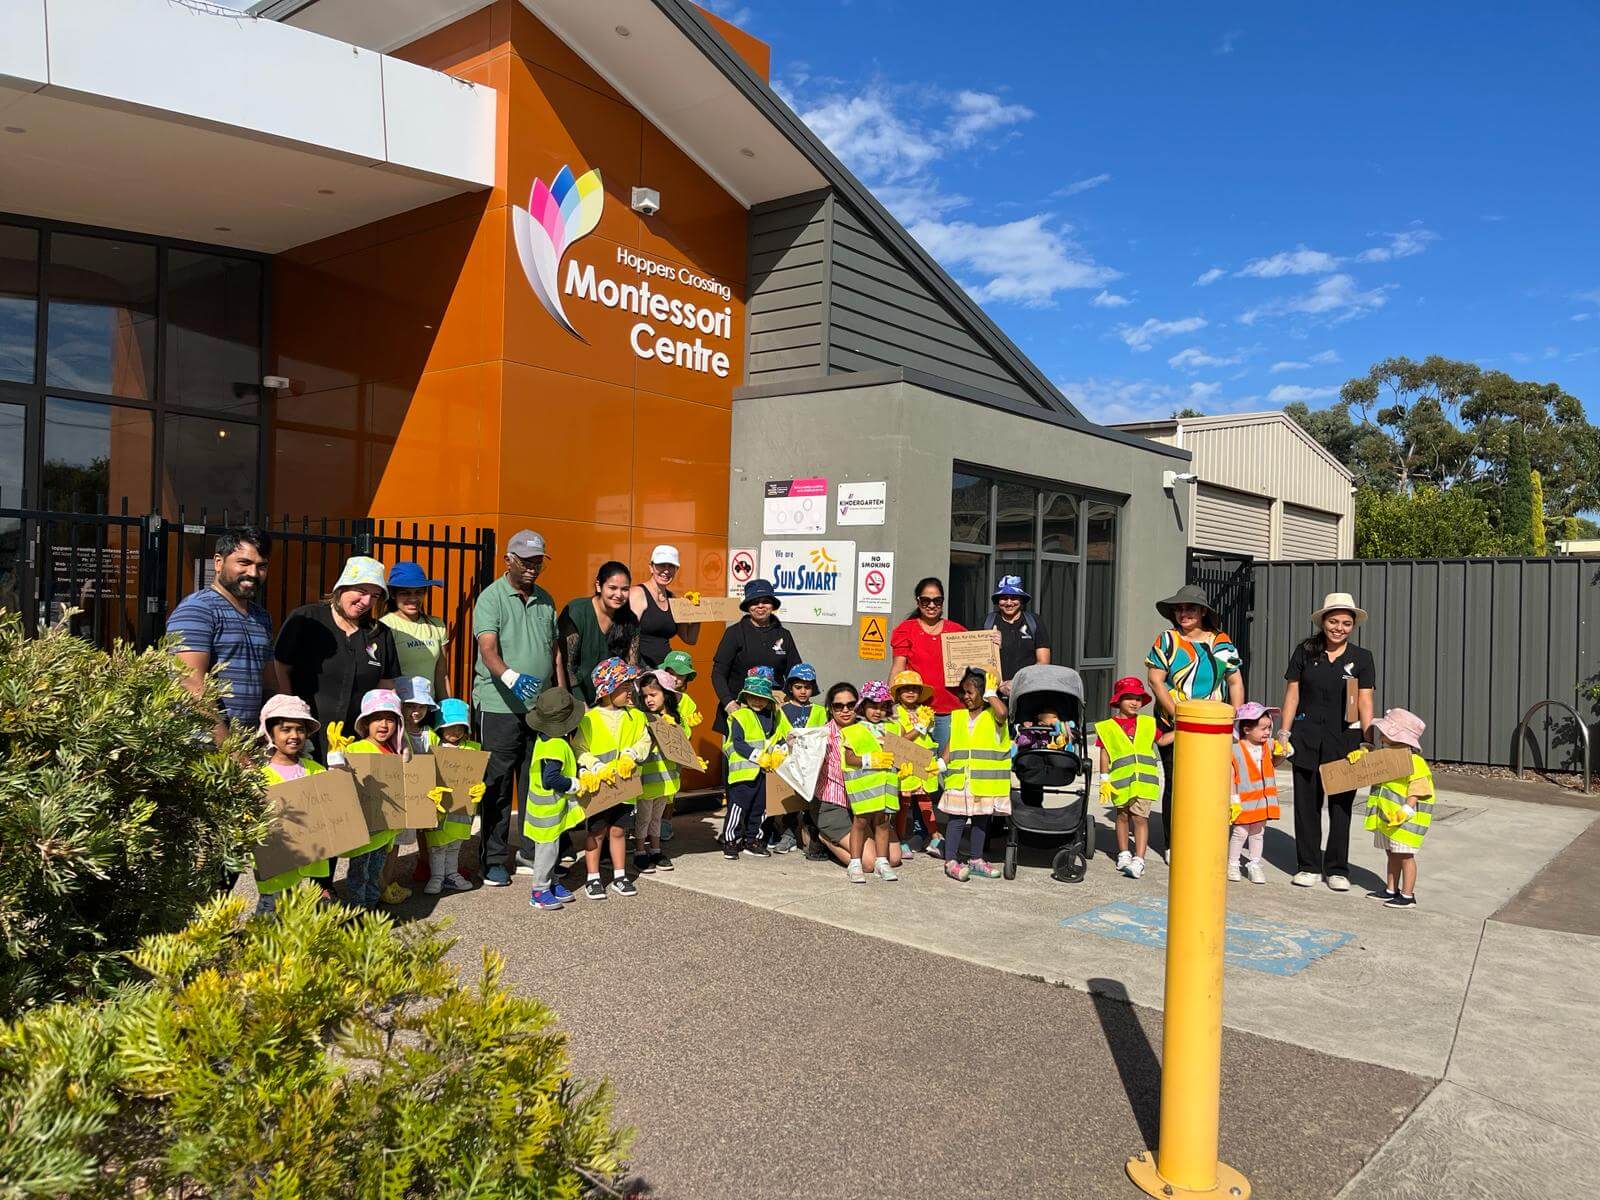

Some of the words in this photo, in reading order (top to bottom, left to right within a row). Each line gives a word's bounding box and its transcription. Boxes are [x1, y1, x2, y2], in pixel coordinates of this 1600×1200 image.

[564, 259, 732, 339] Montessori
[617, 247, 676, 280] Hoppers
[678, 267, 731, 301] Crossing
[630, 322, 731, 378] Centre
[775, 549, 784, 558] We
